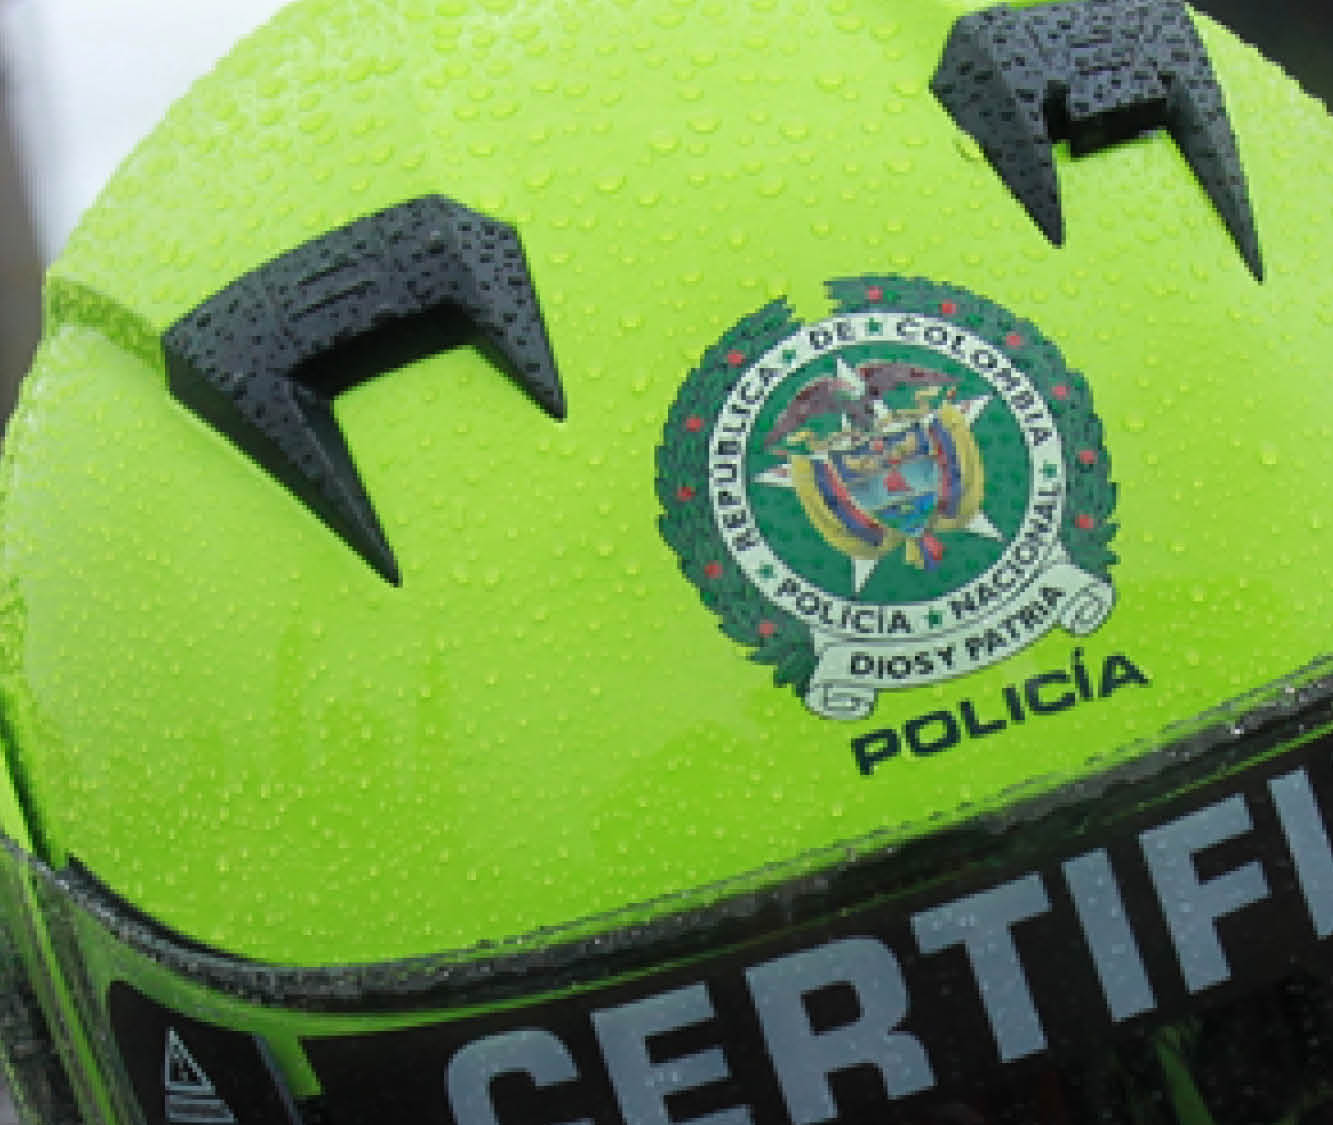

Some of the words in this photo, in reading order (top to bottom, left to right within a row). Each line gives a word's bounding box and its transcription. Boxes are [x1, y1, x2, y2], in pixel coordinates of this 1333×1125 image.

[809, 321, 857, 350] DE
[896, 316, 1052, 447] COLOMBIA
[950, 486, 1058, 619] NACIONAL
[965, 585, 1064, 662] PATRIA
[850, 646, 1149, 776] POLICÍA
